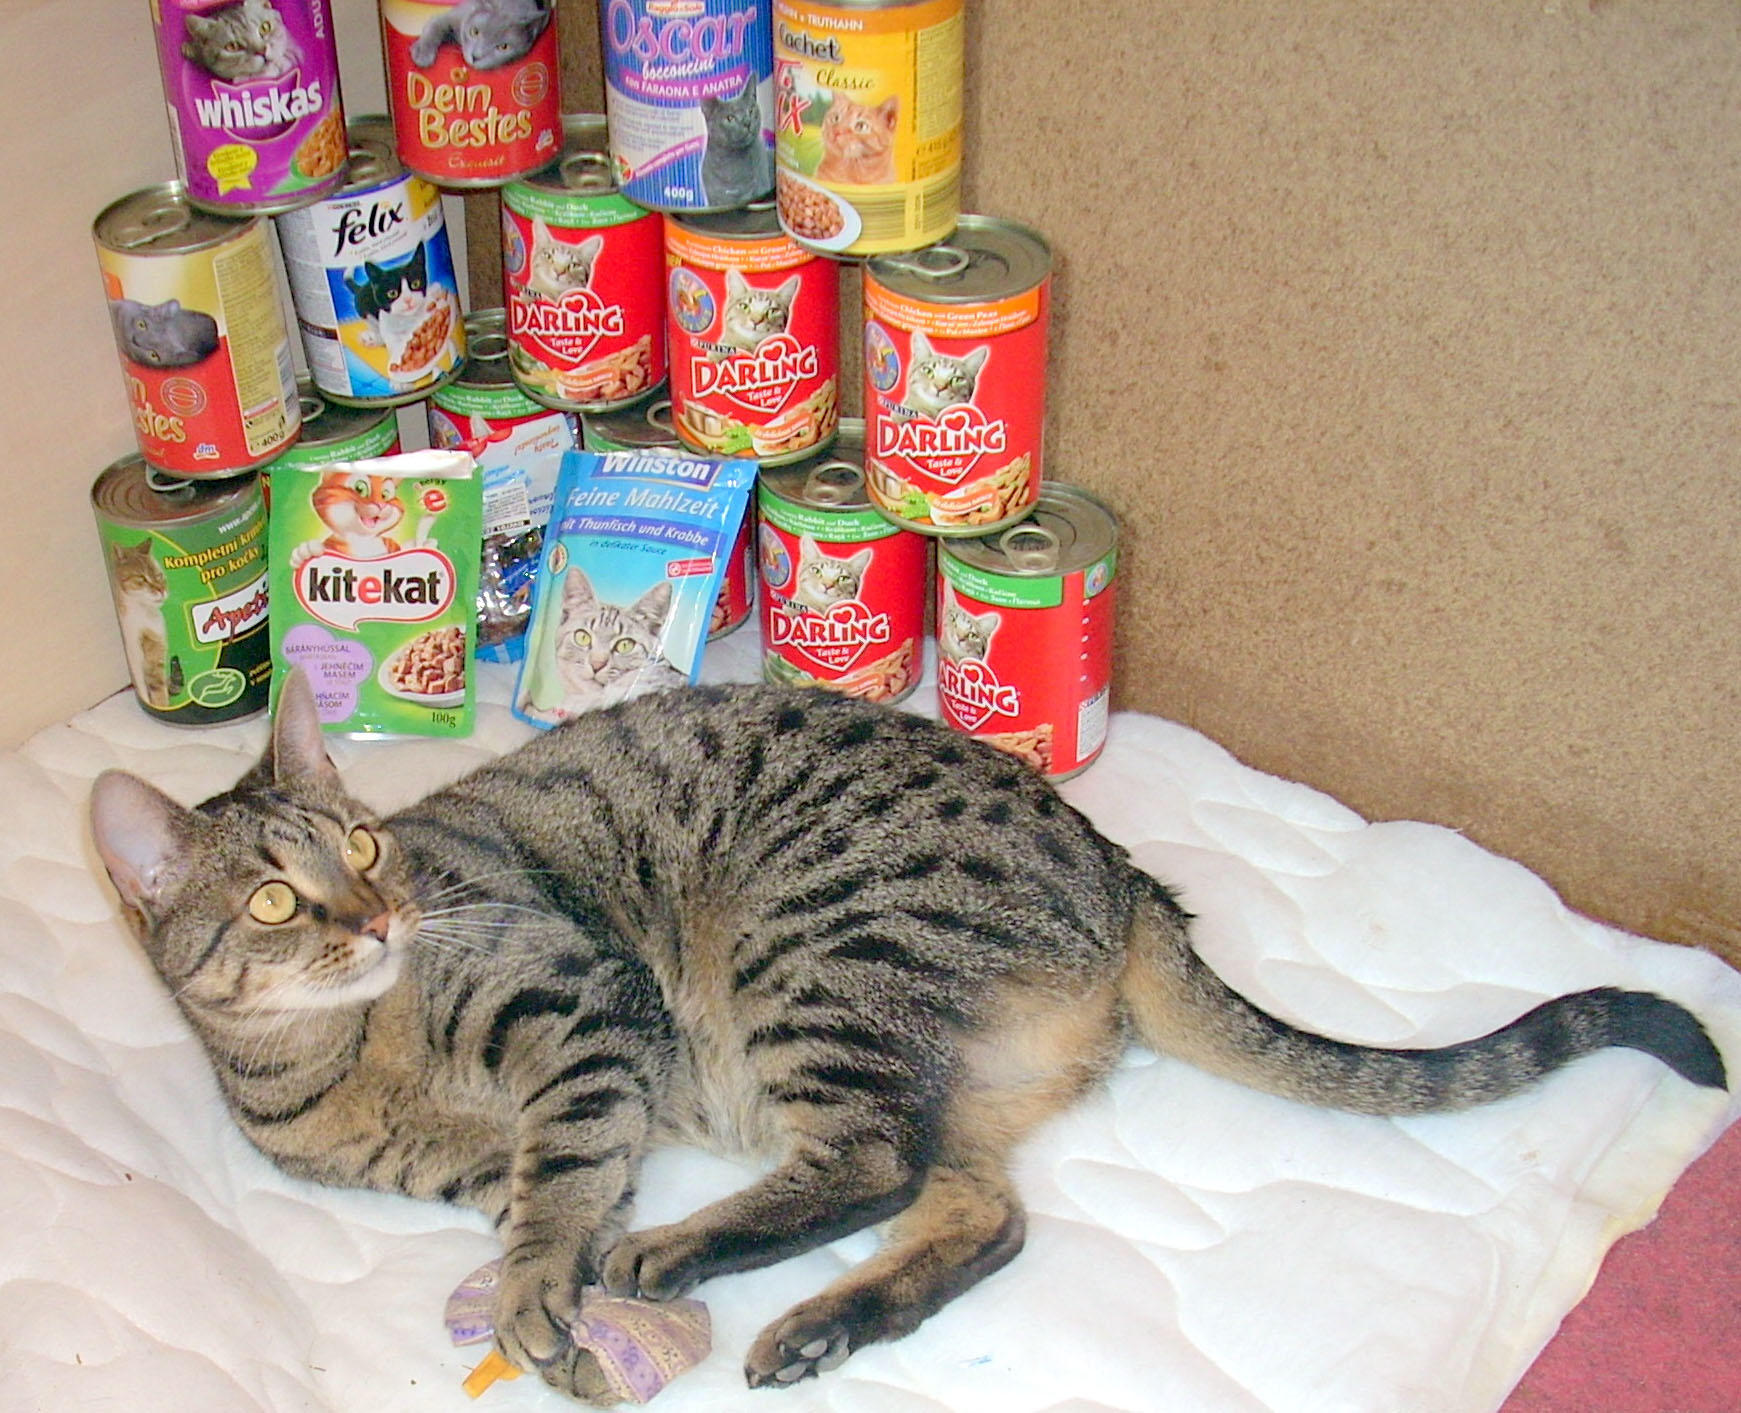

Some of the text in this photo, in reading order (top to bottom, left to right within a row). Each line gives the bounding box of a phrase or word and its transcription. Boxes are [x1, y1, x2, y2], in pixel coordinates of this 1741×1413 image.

[608, 0, 758, 62] Oscar
[807, 13, 864, 31] TRUTHAHN
[778, 22, 843, 63] Cachet
[642, 54, 715, 81] bocconcini
[816, 68, 875, 91] Classic
[407, 67, 492, 113] Dein
[642, 82, 690, 97] FARAONA
[692, 83, 699, 96] E
[702, 74, 743, 96] ANATRA
[195, 80, 323, 128] whiskas
[419, 106, 533, 149] Bestes
[664, 186, 694, 201] 400g
[332, 201, 404, 257] felix
[510, 295, 625, 337] DARLING
[551, 336, 574, 347] Taste
[562, 345, 585, 355] Love
[690, 344, 819, 398] DARLING
[747, 387, 773, 402] Taste
[760, 396, 783, 407] Love
[877, 415, 1006, 458] DARLING
[601, 453, 711, 481] Winston
[926, 459, 952, 470] Taste
[939, 466, 964, 478] Love
[565, 486, 621, 507] Feine
[624, 487, 720, 520] Mahlzeit
[577, 517, 637, 535] Thunfisch
[638, 524, 663, 537] und
[664, 527, 709, 546] Krabbe
[164, 541, 238, 569] Kompletní
[200, 567, 226, 585] pro
[309, 566, 441, 605] kitekat
[770, 606, 892, 646] DARLING
[816, 647, 842, 657] Taste
[828, 655, 850, 665] Love
[432, 711, 456, 729] 100g
[959, 709, 978, 723] Love
